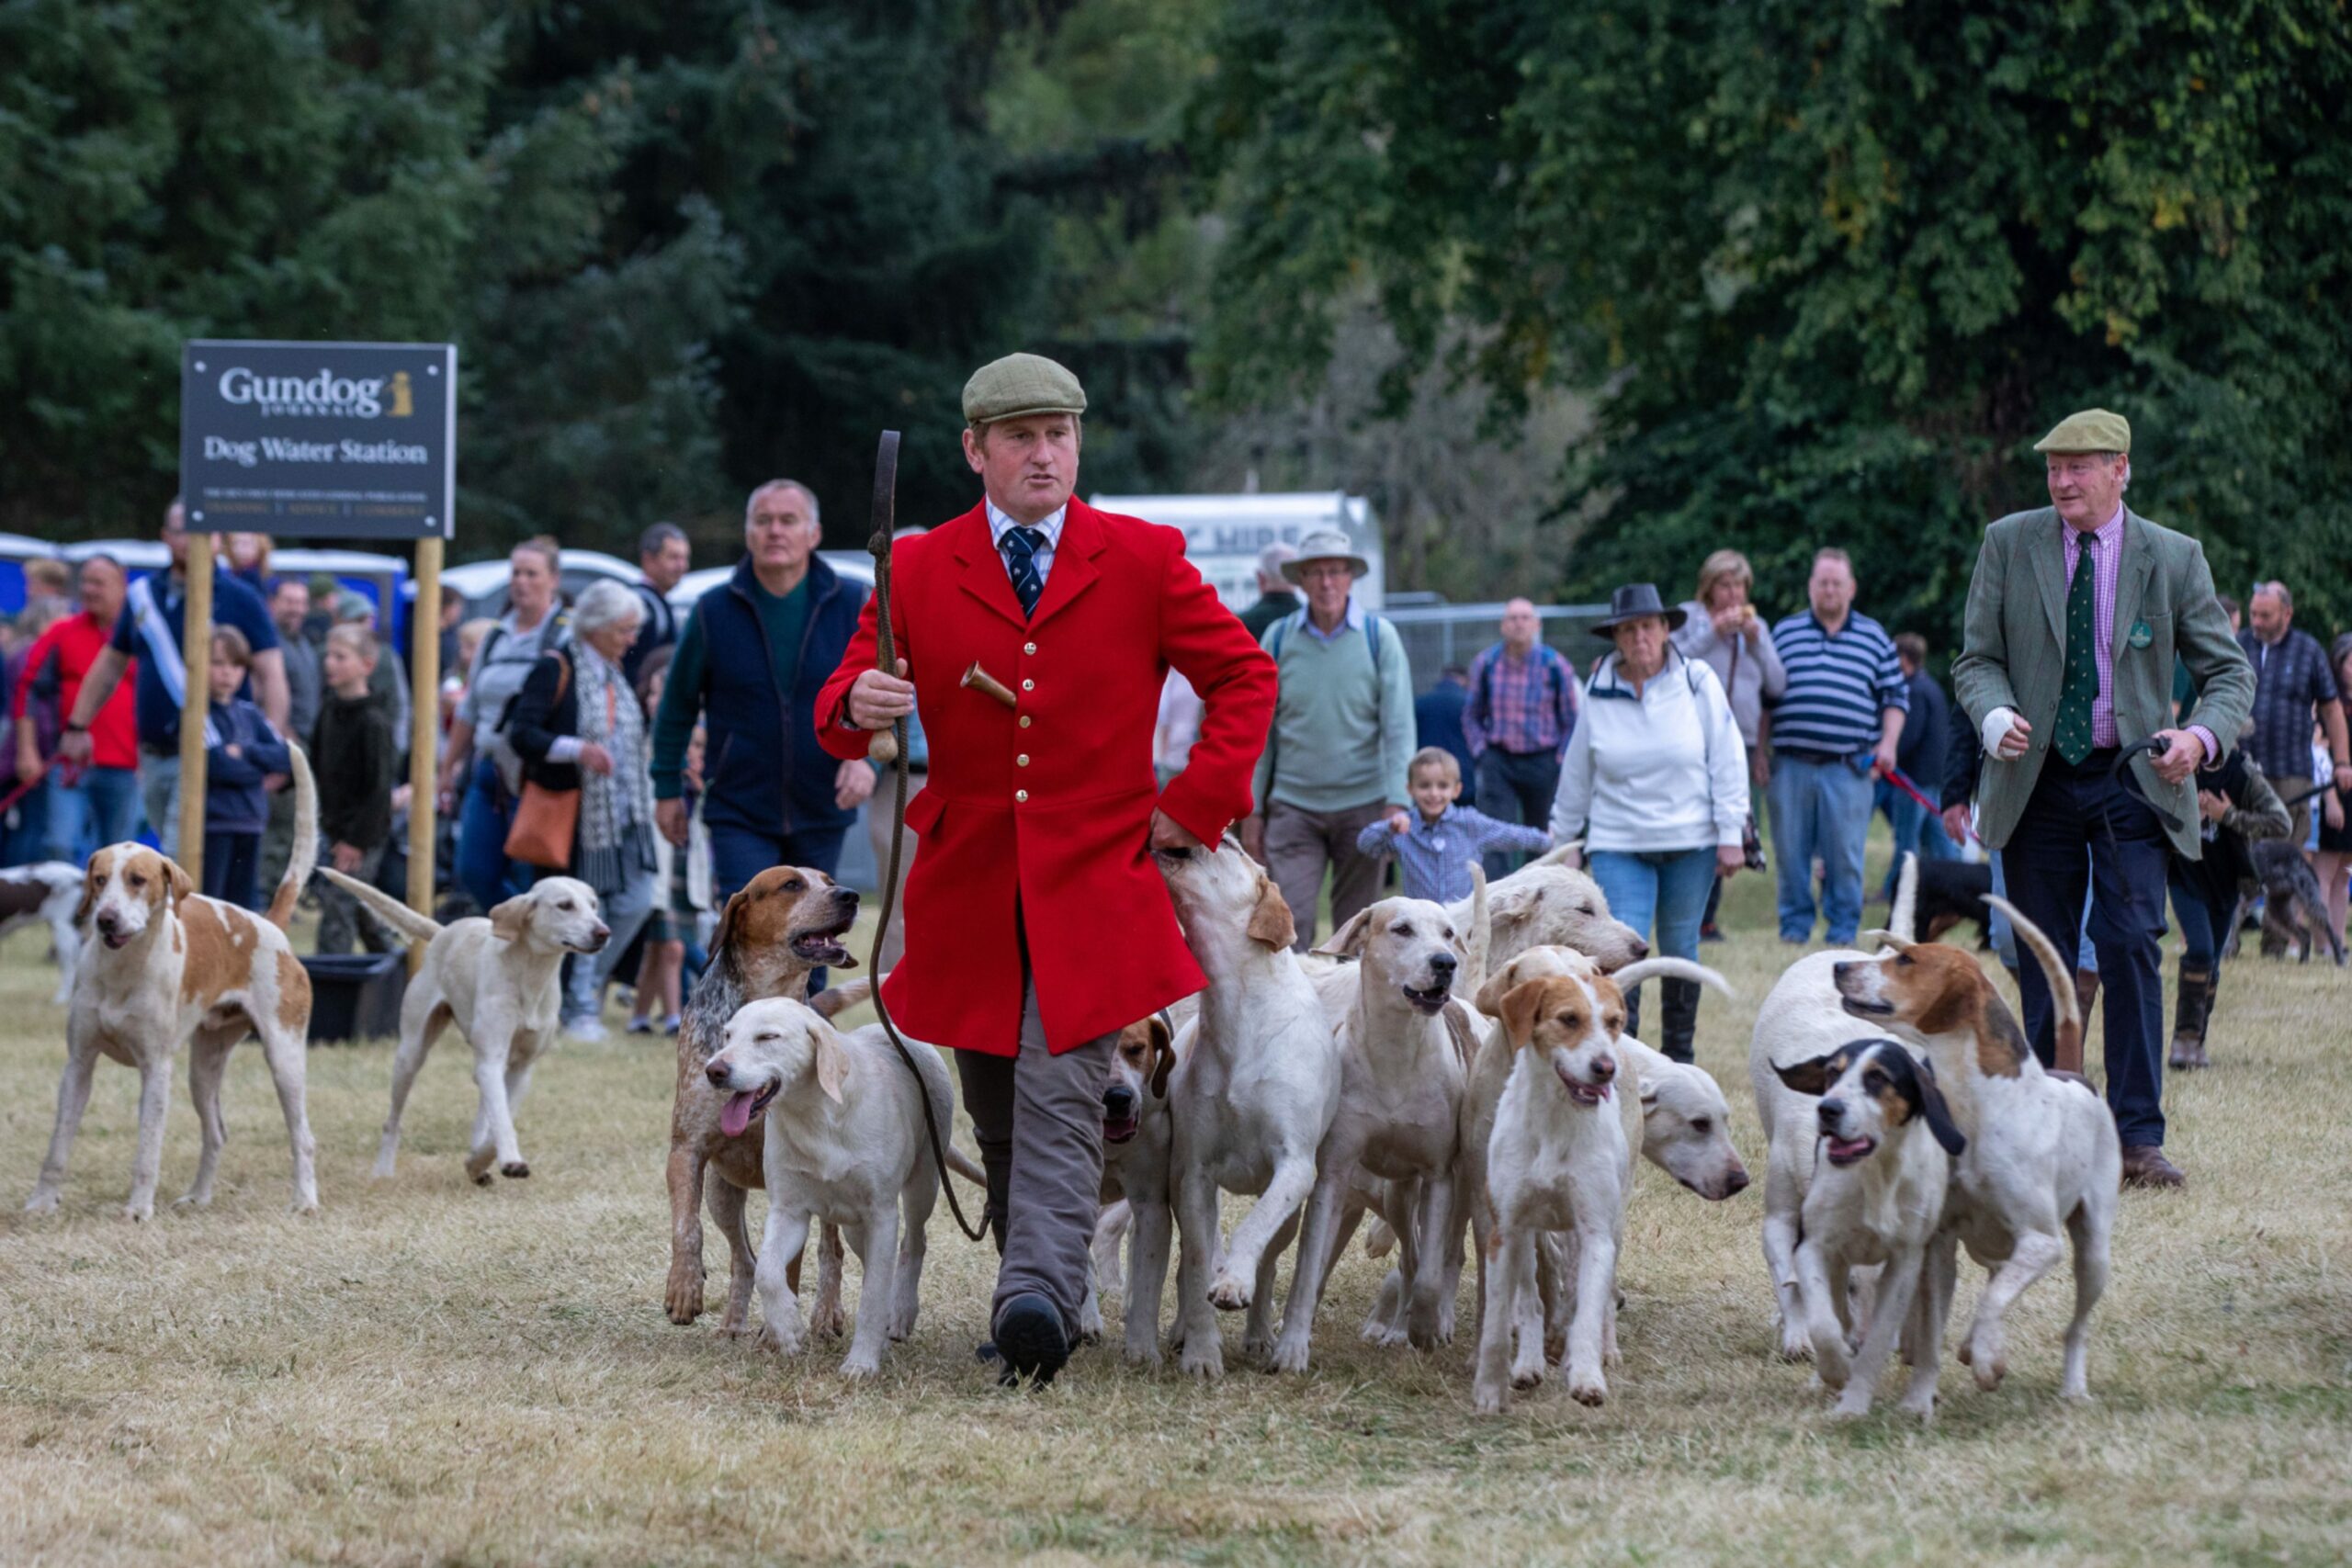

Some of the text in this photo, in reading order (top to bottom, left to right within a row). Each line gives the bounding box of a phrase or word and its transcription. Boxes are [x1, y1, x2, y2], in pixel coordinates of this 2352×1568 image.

[219, 367, 383, 419] Gundog
[261, 404, 355, 417] JOURNAL
[204, 436, 428, 468] Dog Water Station
